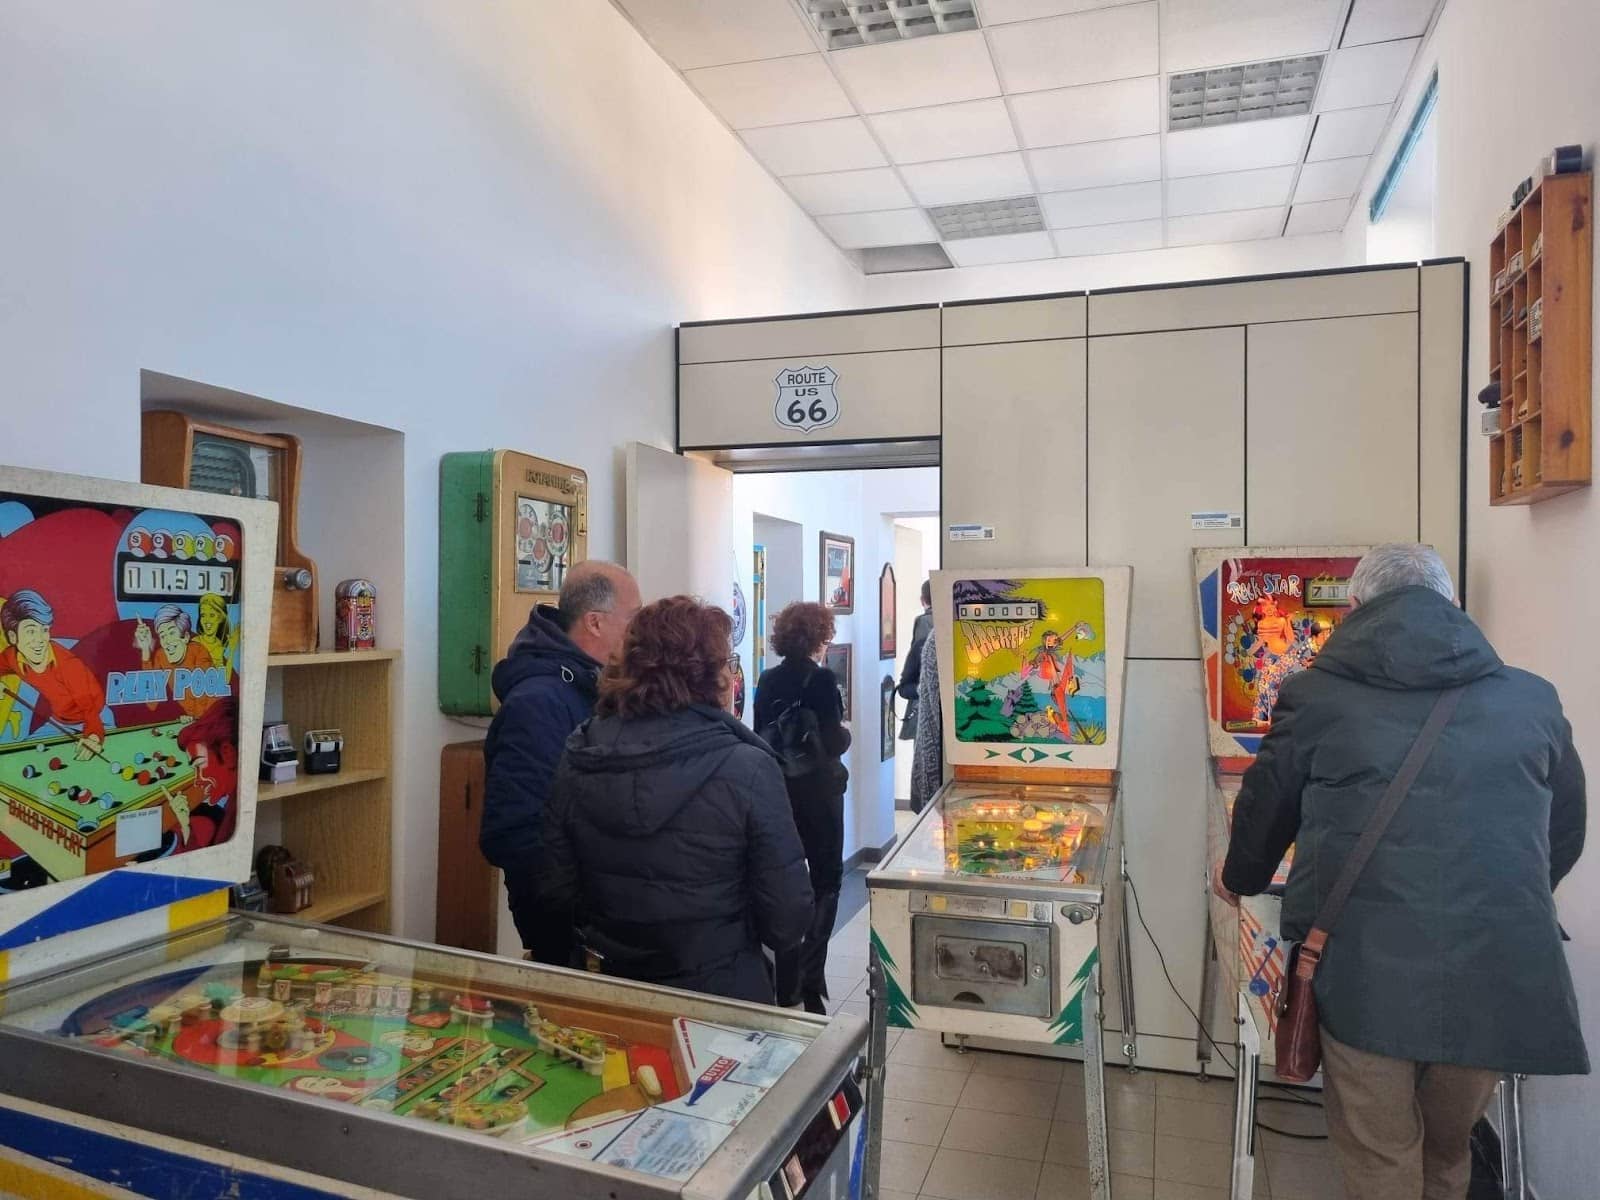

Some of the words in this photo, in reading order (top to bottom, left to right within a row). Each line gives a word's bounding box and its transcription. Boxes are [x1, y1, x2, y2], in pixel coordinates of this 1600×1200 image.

[787, 372, 826, 385] ROUTE
[795, 387, 819, 397] US
[787, 399, 827, 423] 66
[960, 620, 1036, 664] JACKPOT
[106, 669, 171, 706] PLAY
[173, 666, 232, 701] POOL
[8, 798, 40, 831] BALLS
[39, 813, 55, 841] TO
[53, 825, 85, 858] PLAY
[699, 1056, 731, 1083] BUTTO
